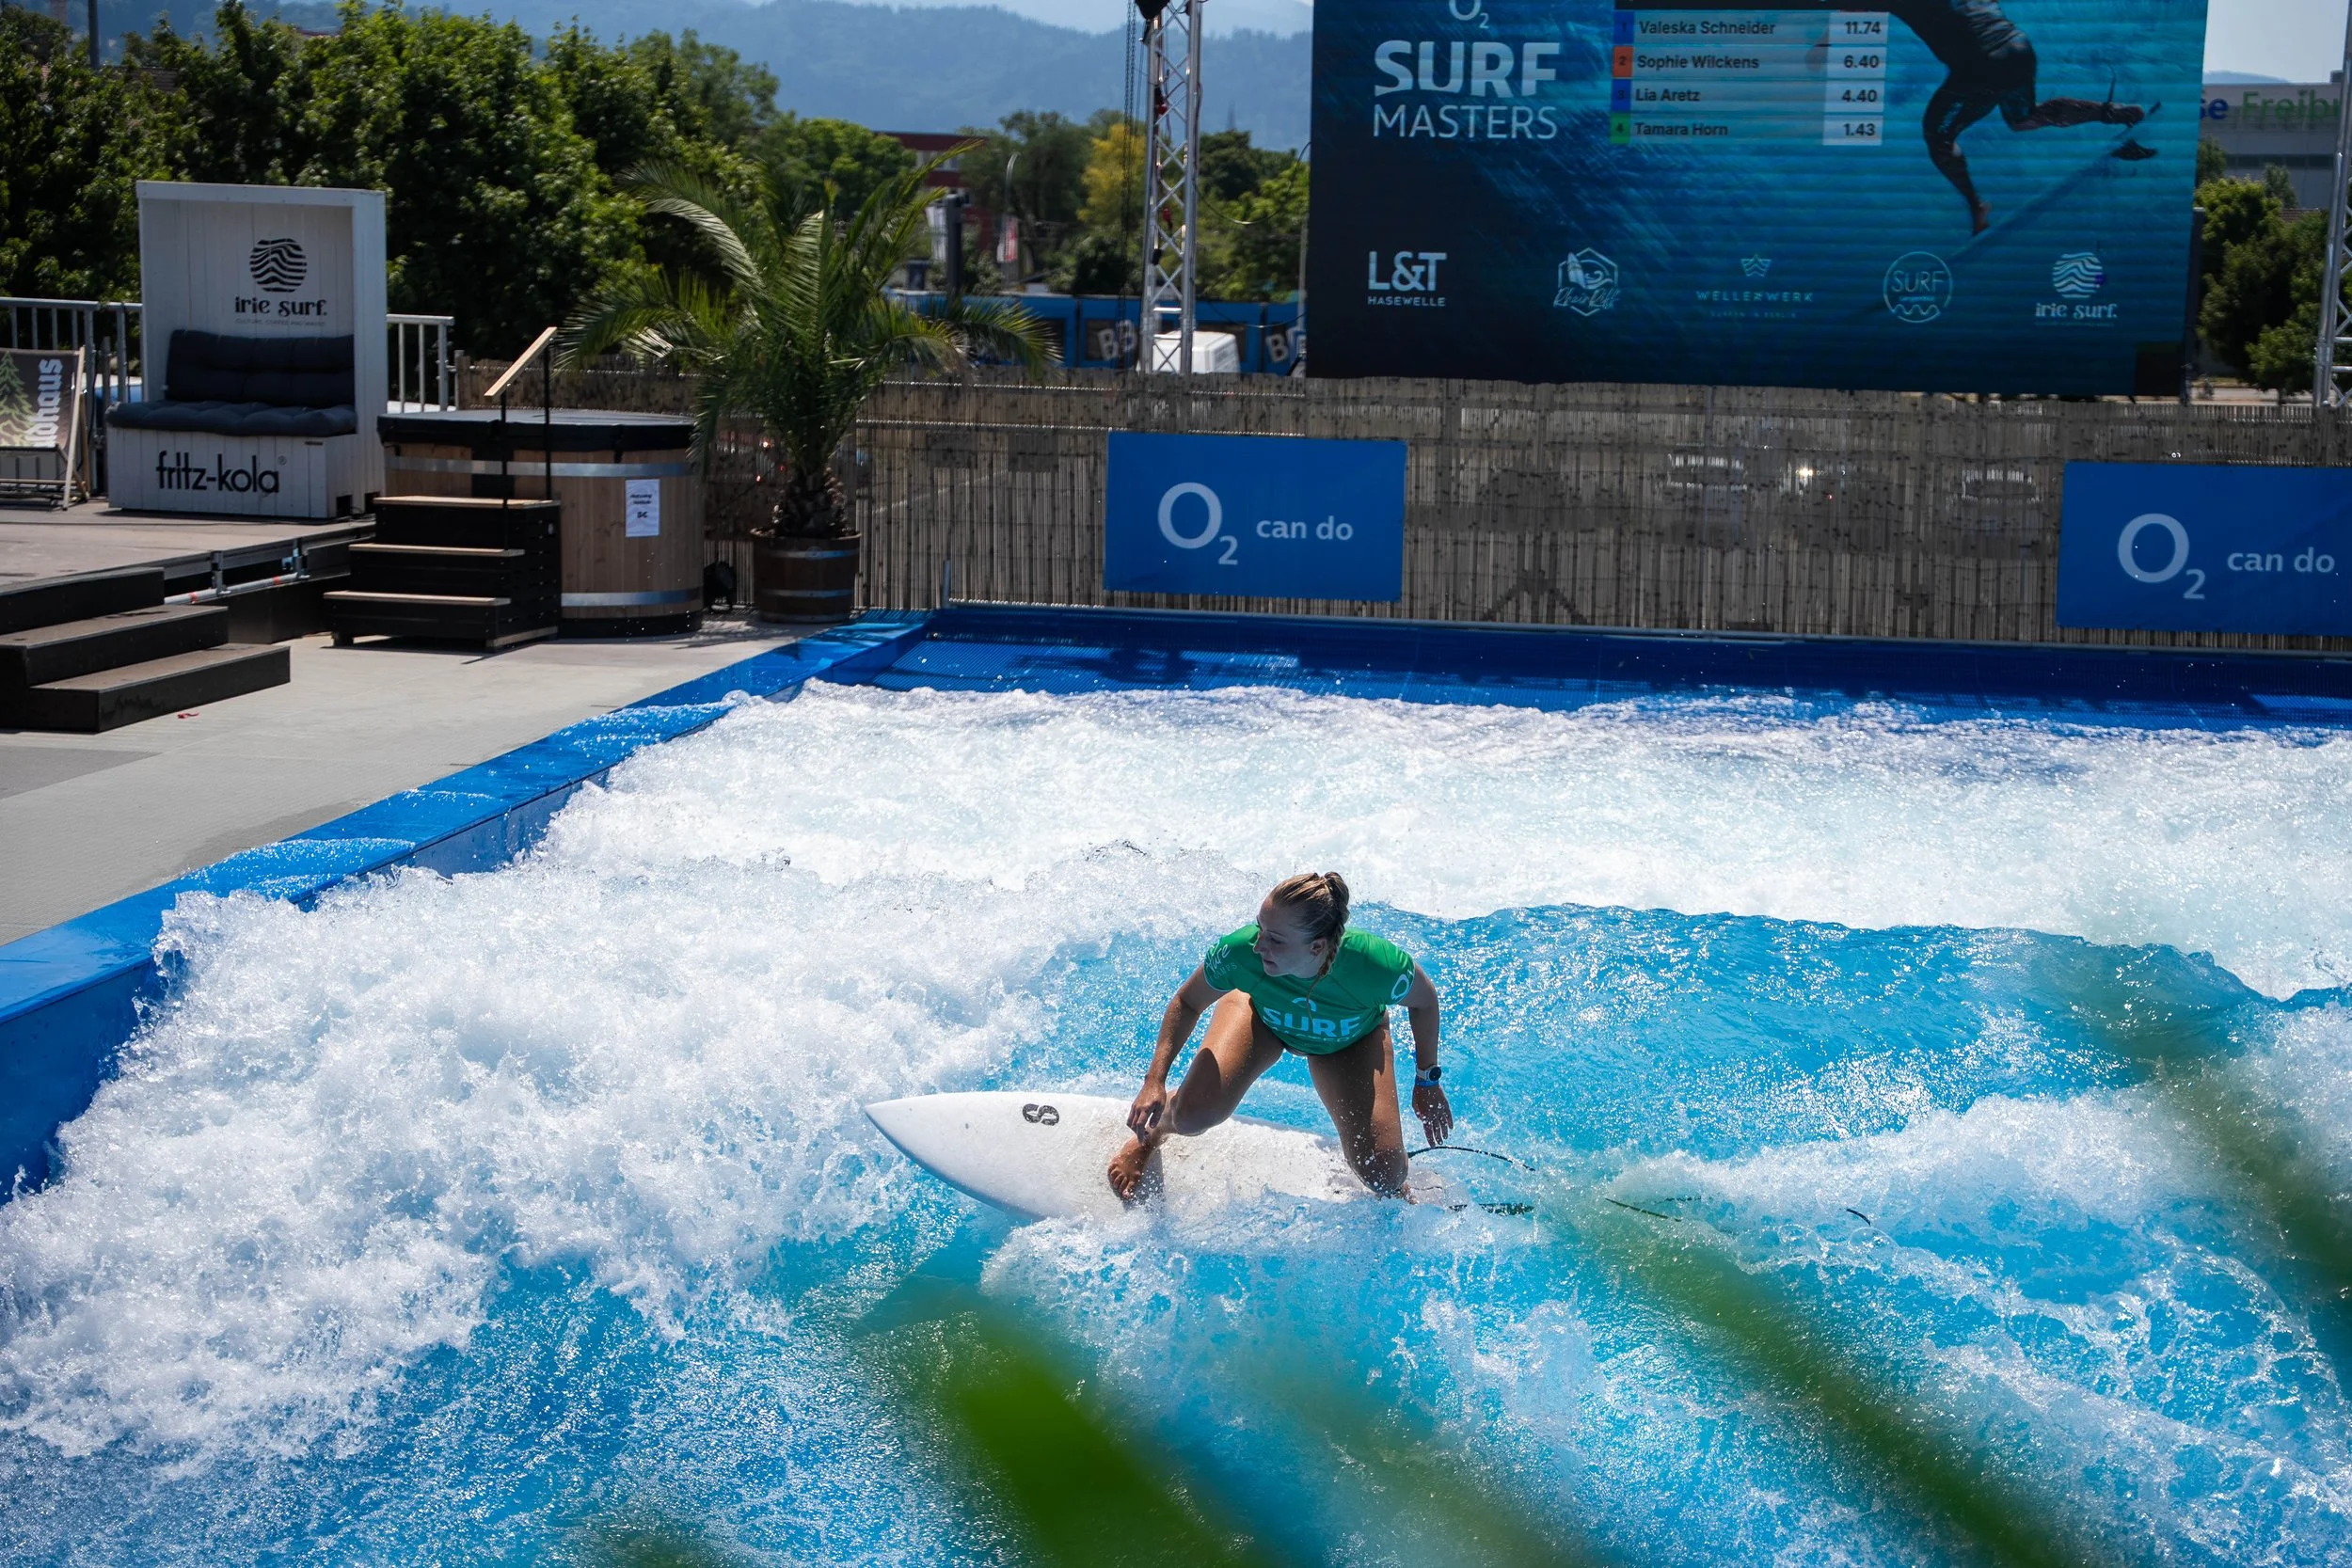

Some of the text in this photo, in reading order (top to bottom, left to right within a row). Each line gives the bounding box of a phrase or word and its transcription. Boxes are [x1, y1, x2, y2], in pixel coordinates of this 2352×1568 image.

[1639, 21, 1696, 34] Valeska
[1700, 21, 1775, 34] Schneider
[1844, 21, 1881, 34] 11.74
[1375, 40, 1560, 97] SURF
[1637, 55, 1688, 71] Sophie
[1692, 55, 1759, 69] Wilckens
[1843, 55, 1880, 69] 6.40
[1635, 88, 1657, 102] Lia
[1660, 88, 1701, 102] Aretz
[1841, 89, 1878, 103] 4.40
[1373, 104, 1558, 139] MASTERS
[1635, 122, 1689, 135] Tamara
[1692, 122, 1728, 135] Horn
[1843, 123, 1876, 136] 1.43
[1368, 251, 1448, 292] L&T
[1891, 269, 1946, 293] SURF
[234, 295, 271, 314] irie
[1367, 295, 1447, 308] HASEWELLE
[1694, 291, 1814, 303] WELLENWERK
[2034, 302, 2069, 318] irie
[1157, 482, 1354, 566] O2 can do
[2117, 513, 2336, 601] O2 can do
[1263, 1006, 1361, 1038] SURF
